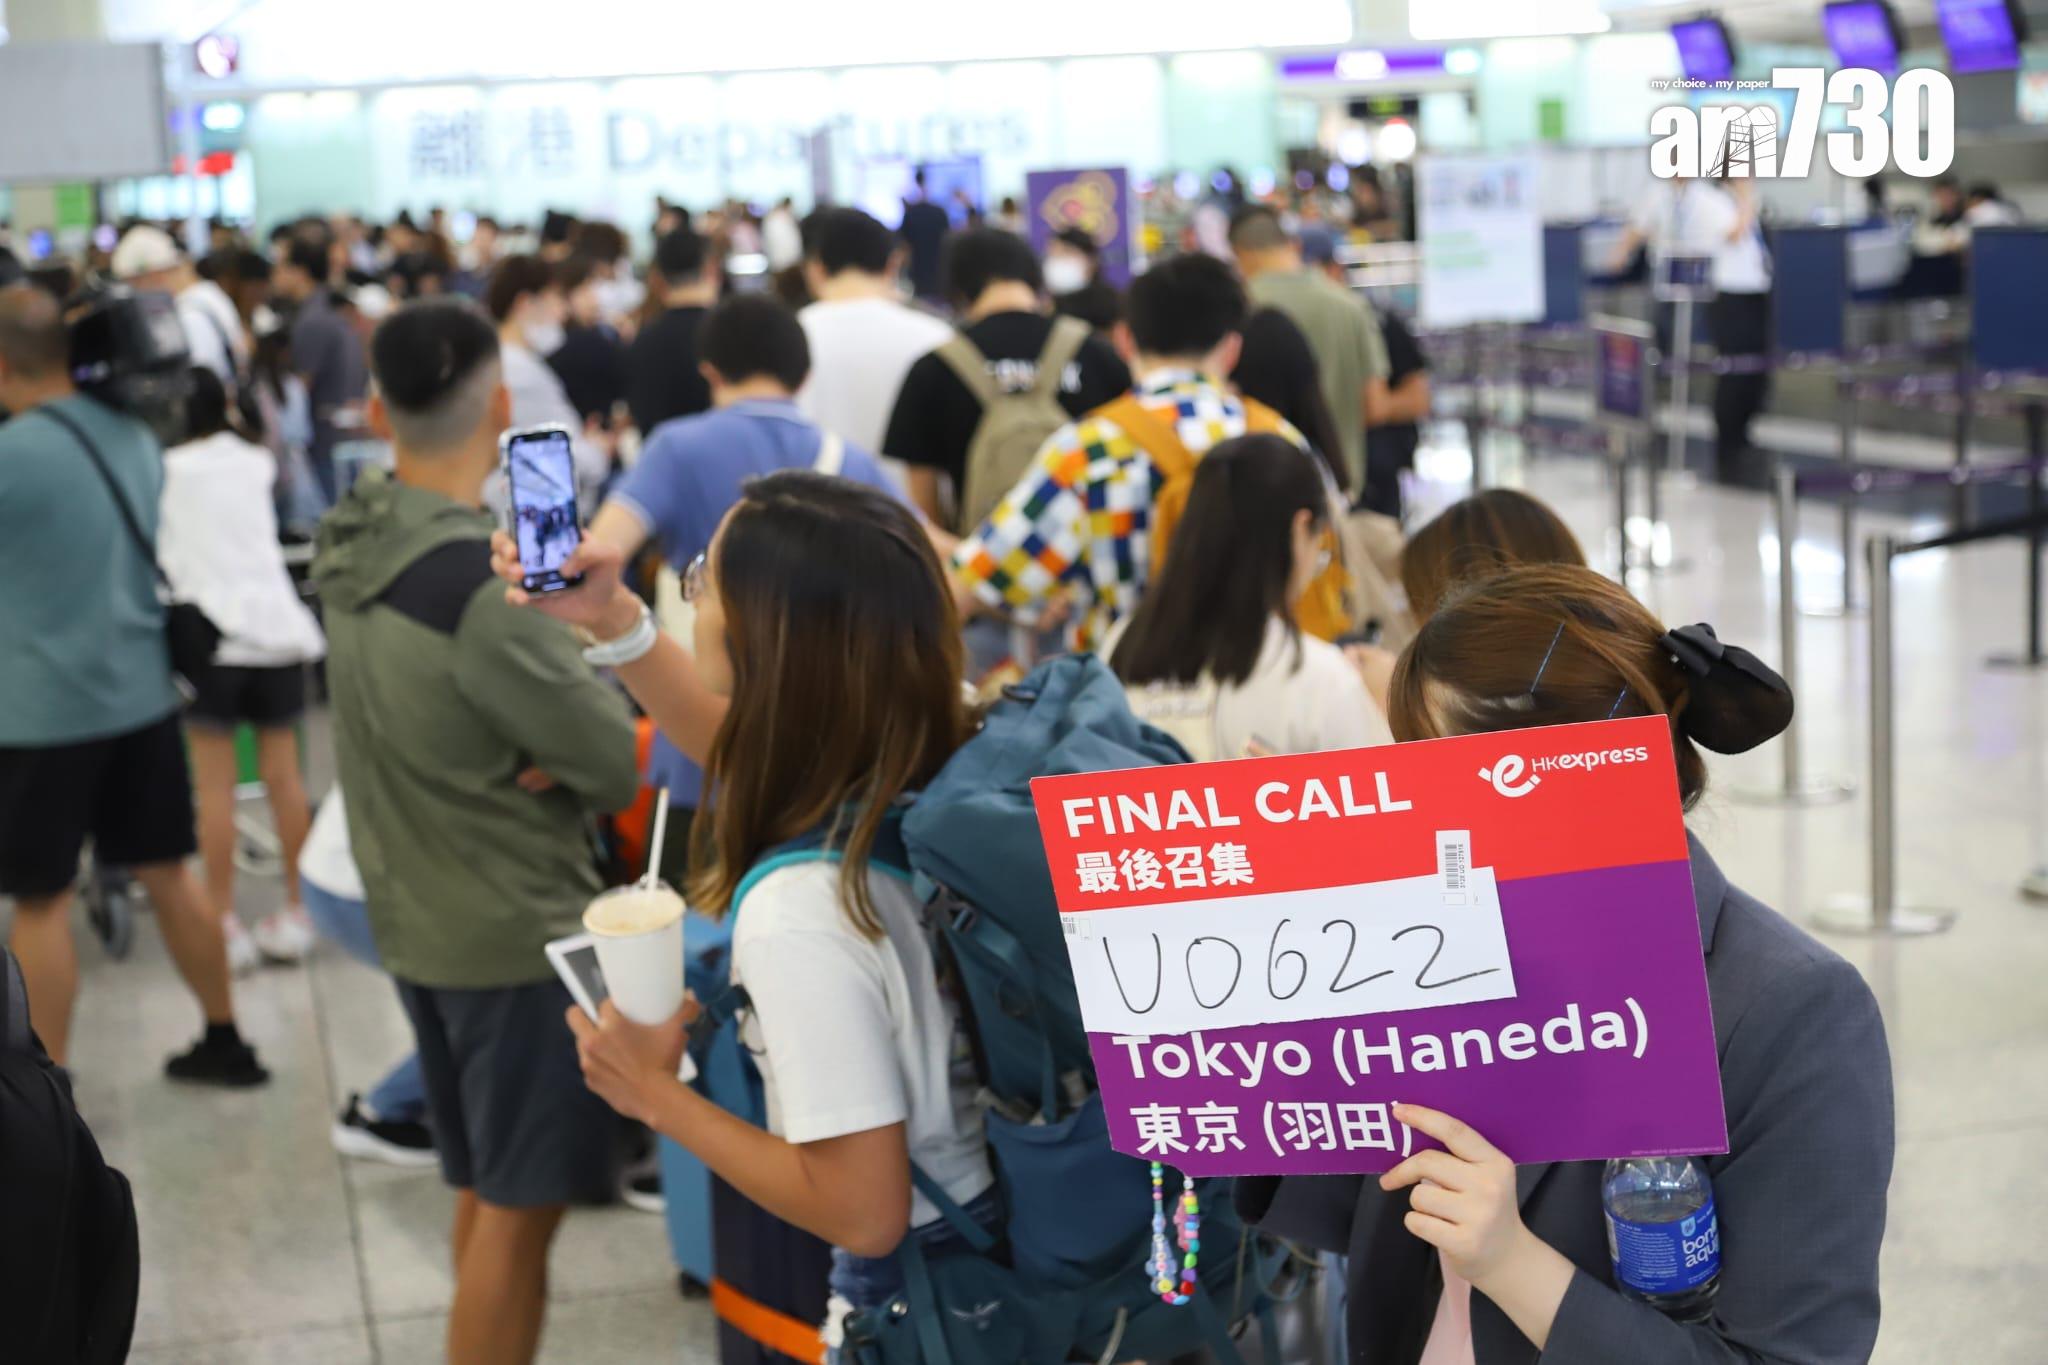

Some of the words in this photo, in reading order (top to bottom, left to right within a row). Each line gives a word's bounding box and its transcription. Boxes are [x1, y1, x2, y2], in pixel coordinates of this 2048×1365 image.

[607, 109, 1029, 172] Depatures
[1062, 787, 1241, 837] FINAL
[1255, 772, 1413, 823] CALL
[1075, 842, 1255, 894] 最後召集
[1112, 1032, 1312, 1088] Tokyo
[1333, 998, 1649, 1086] (Haneda)
[1129, 1100, 1247, 1155] 東京
[1264, 1101, 1412, 1158] (羽田)
[1682, 1227, 1714, 1254] bon
